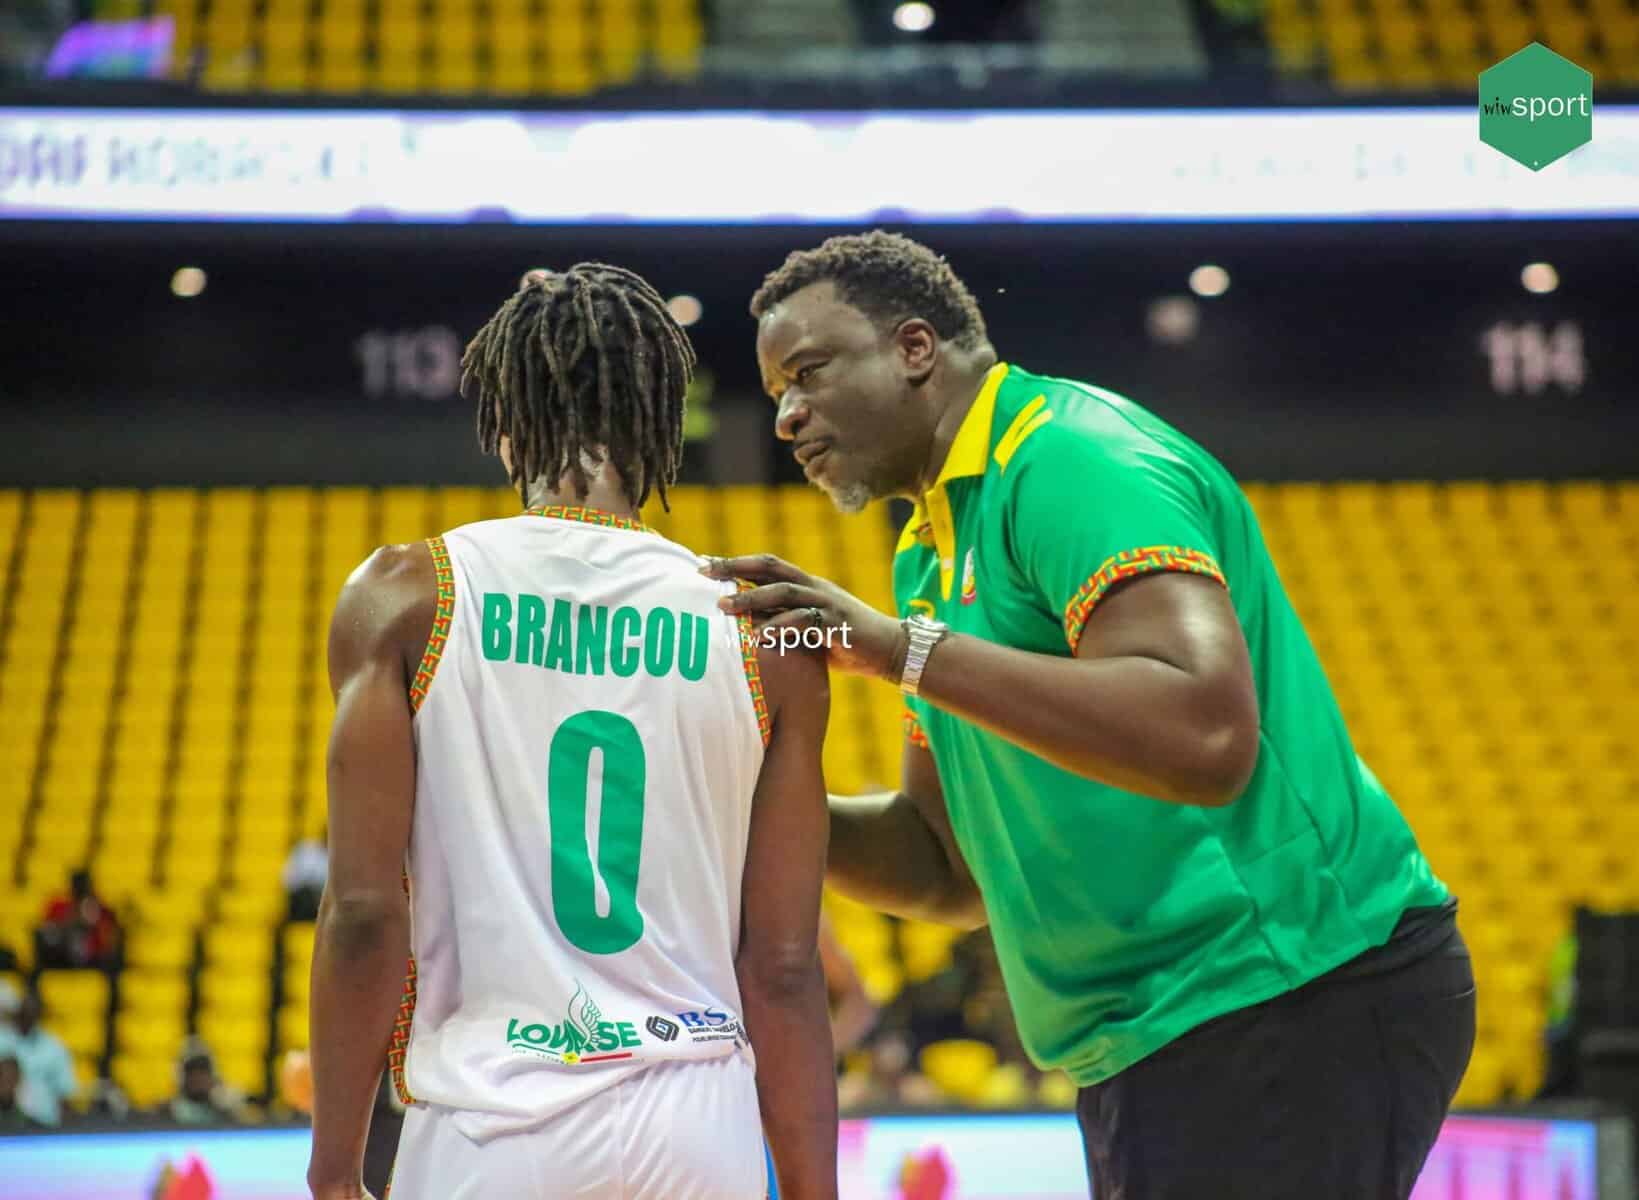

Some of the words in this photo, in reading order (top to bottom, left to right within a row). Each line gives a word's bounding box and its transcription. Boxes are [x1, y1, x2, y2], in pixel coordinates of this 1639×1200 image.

[1483, 323, 1585, 394] 114
[482, 592, 709, 681] BRANCOU
[548, 710, 646, 955] 0
